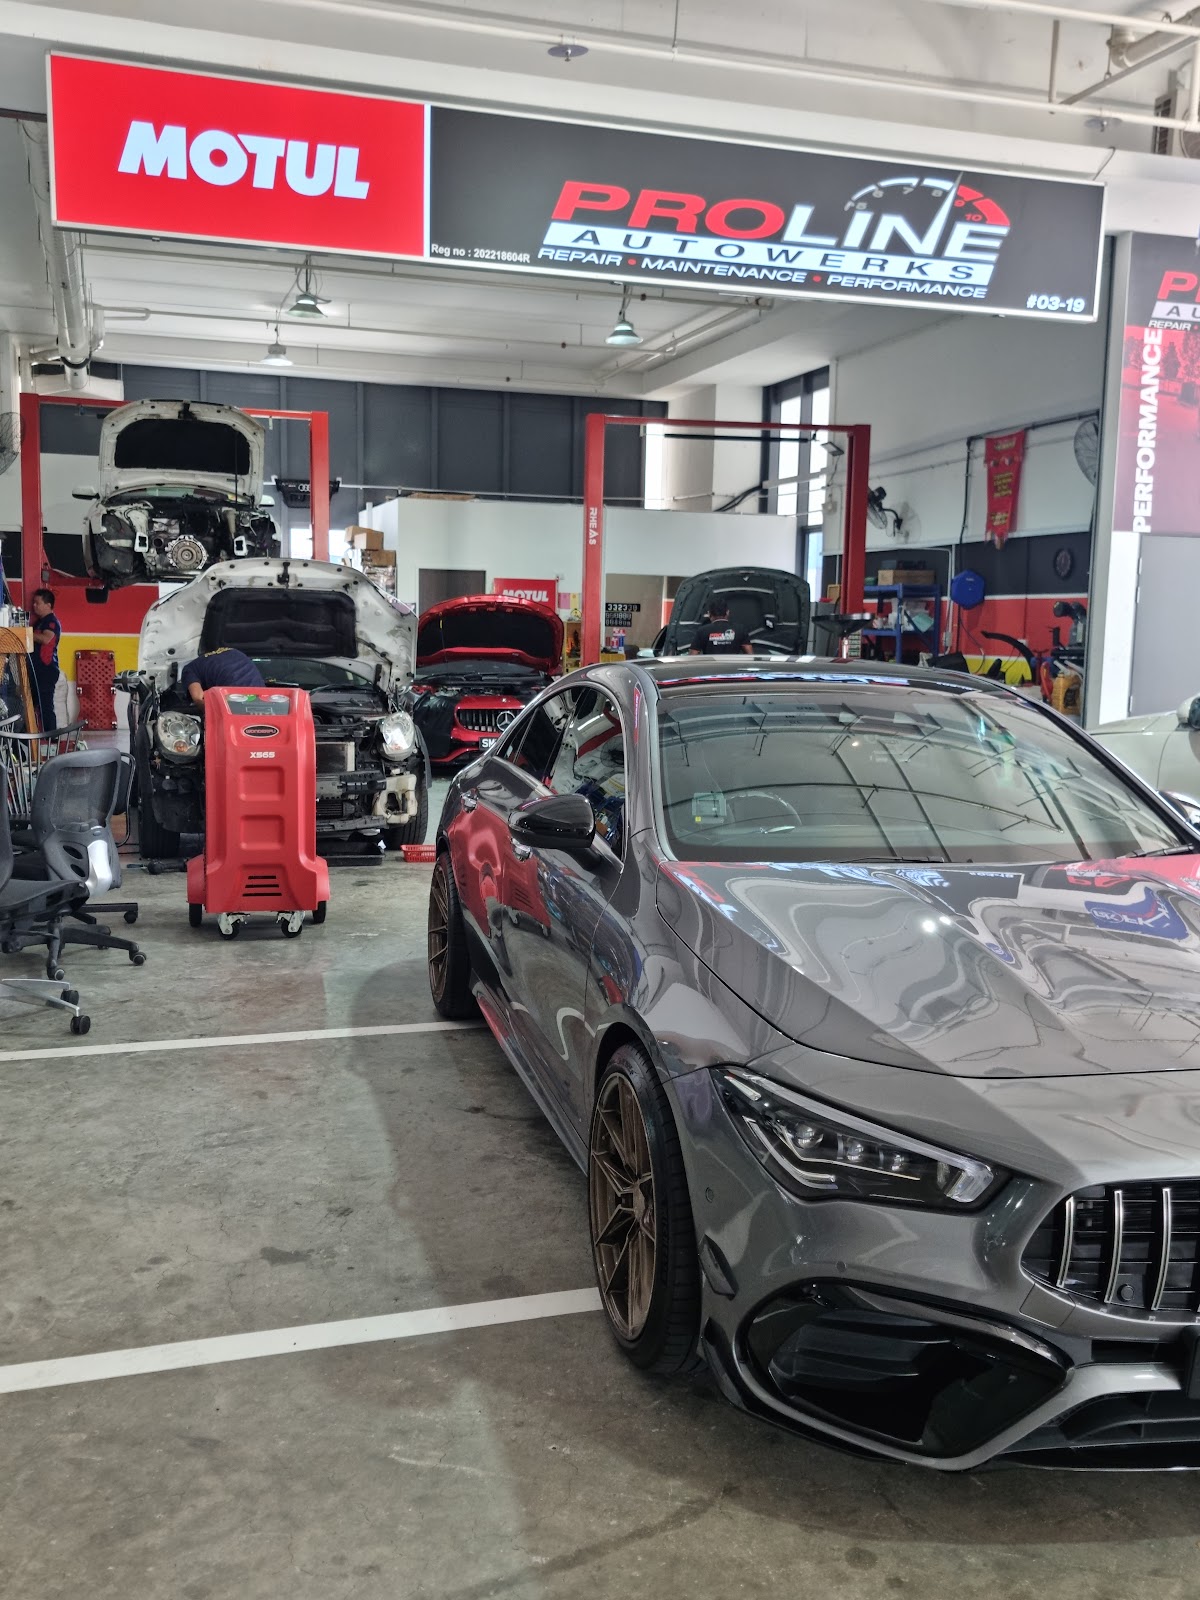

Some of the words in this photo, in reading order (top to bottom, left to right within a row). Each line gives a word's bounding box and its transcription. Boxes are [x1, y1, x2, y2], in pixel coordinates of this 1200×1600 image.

[118, 120, 370, 200] MOTUL
[551, 180, 1011, 263] PROLINE
[431, 243, 450, 257] Reg
[453, 248, 465, 256] no
[473, 248, 530, 263] 202218604R
[537, 247, 622, 267] REPAIR
[641, 257, 807, 284] MAINTENANCE
[826, 273, 988, 298] PERFORMANCE
[571, 229, 975, 281] AUTOWERKS
[1026, 294, 1085, 313] #03-19
[1157, 270, 1200, 303] P
[1148, 320, 1191, 331] REPAIR
[1133, 328, 1162, 533] PERFORMANCE
[250, 751, 275, 759] X565
